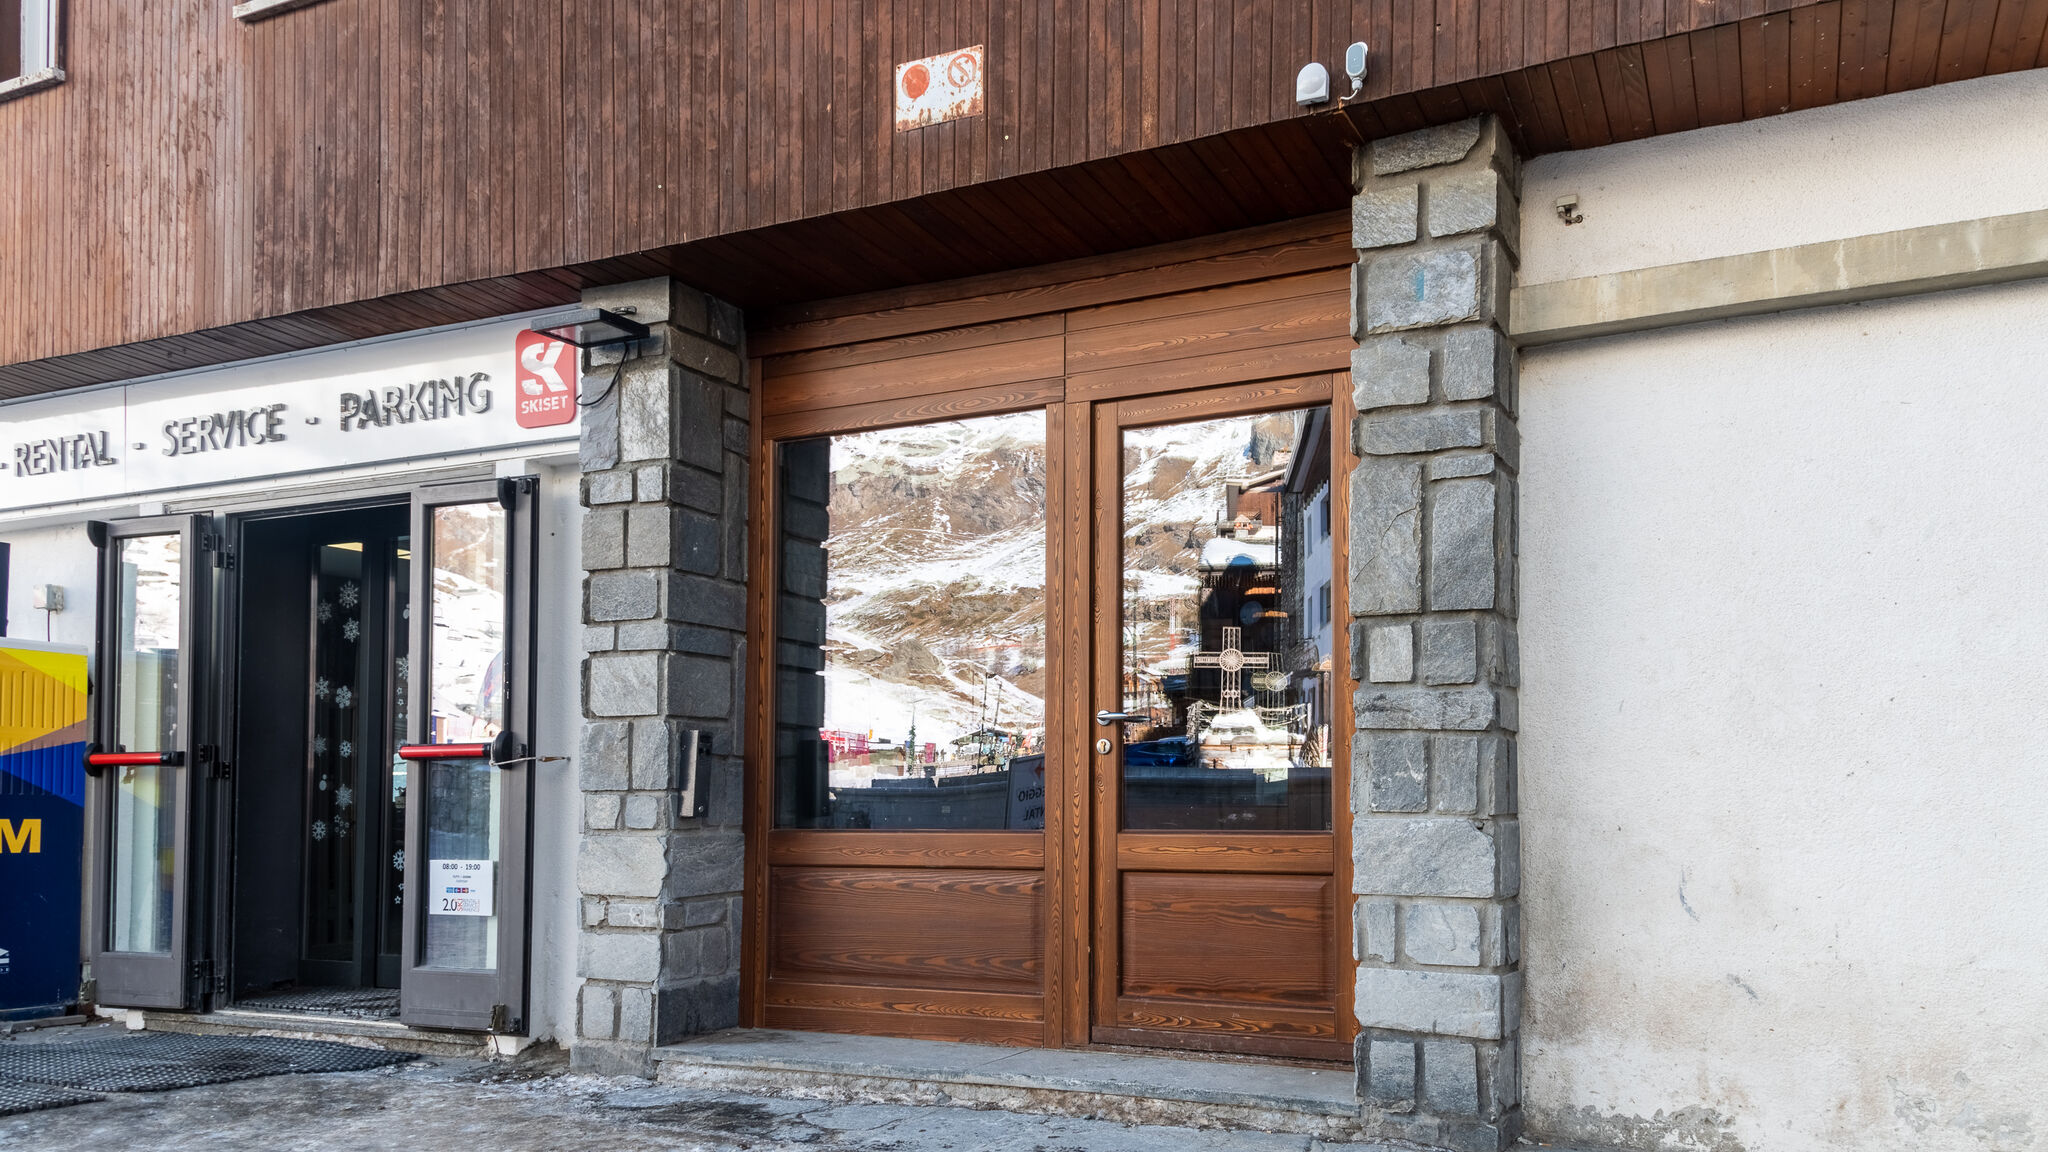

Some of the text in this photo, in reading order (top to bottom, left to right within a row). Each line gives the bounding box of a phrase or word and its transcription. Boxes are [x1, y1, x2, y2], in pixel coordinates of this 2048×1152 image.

[521, 395, 568, 414] SKISET
[14, 430, 117, 477] RENTAL
[162, 403, 288, 457] SERVICE
[340, 372, 493, 432] PARKING
[442, 898, 457, 911] 2.0
